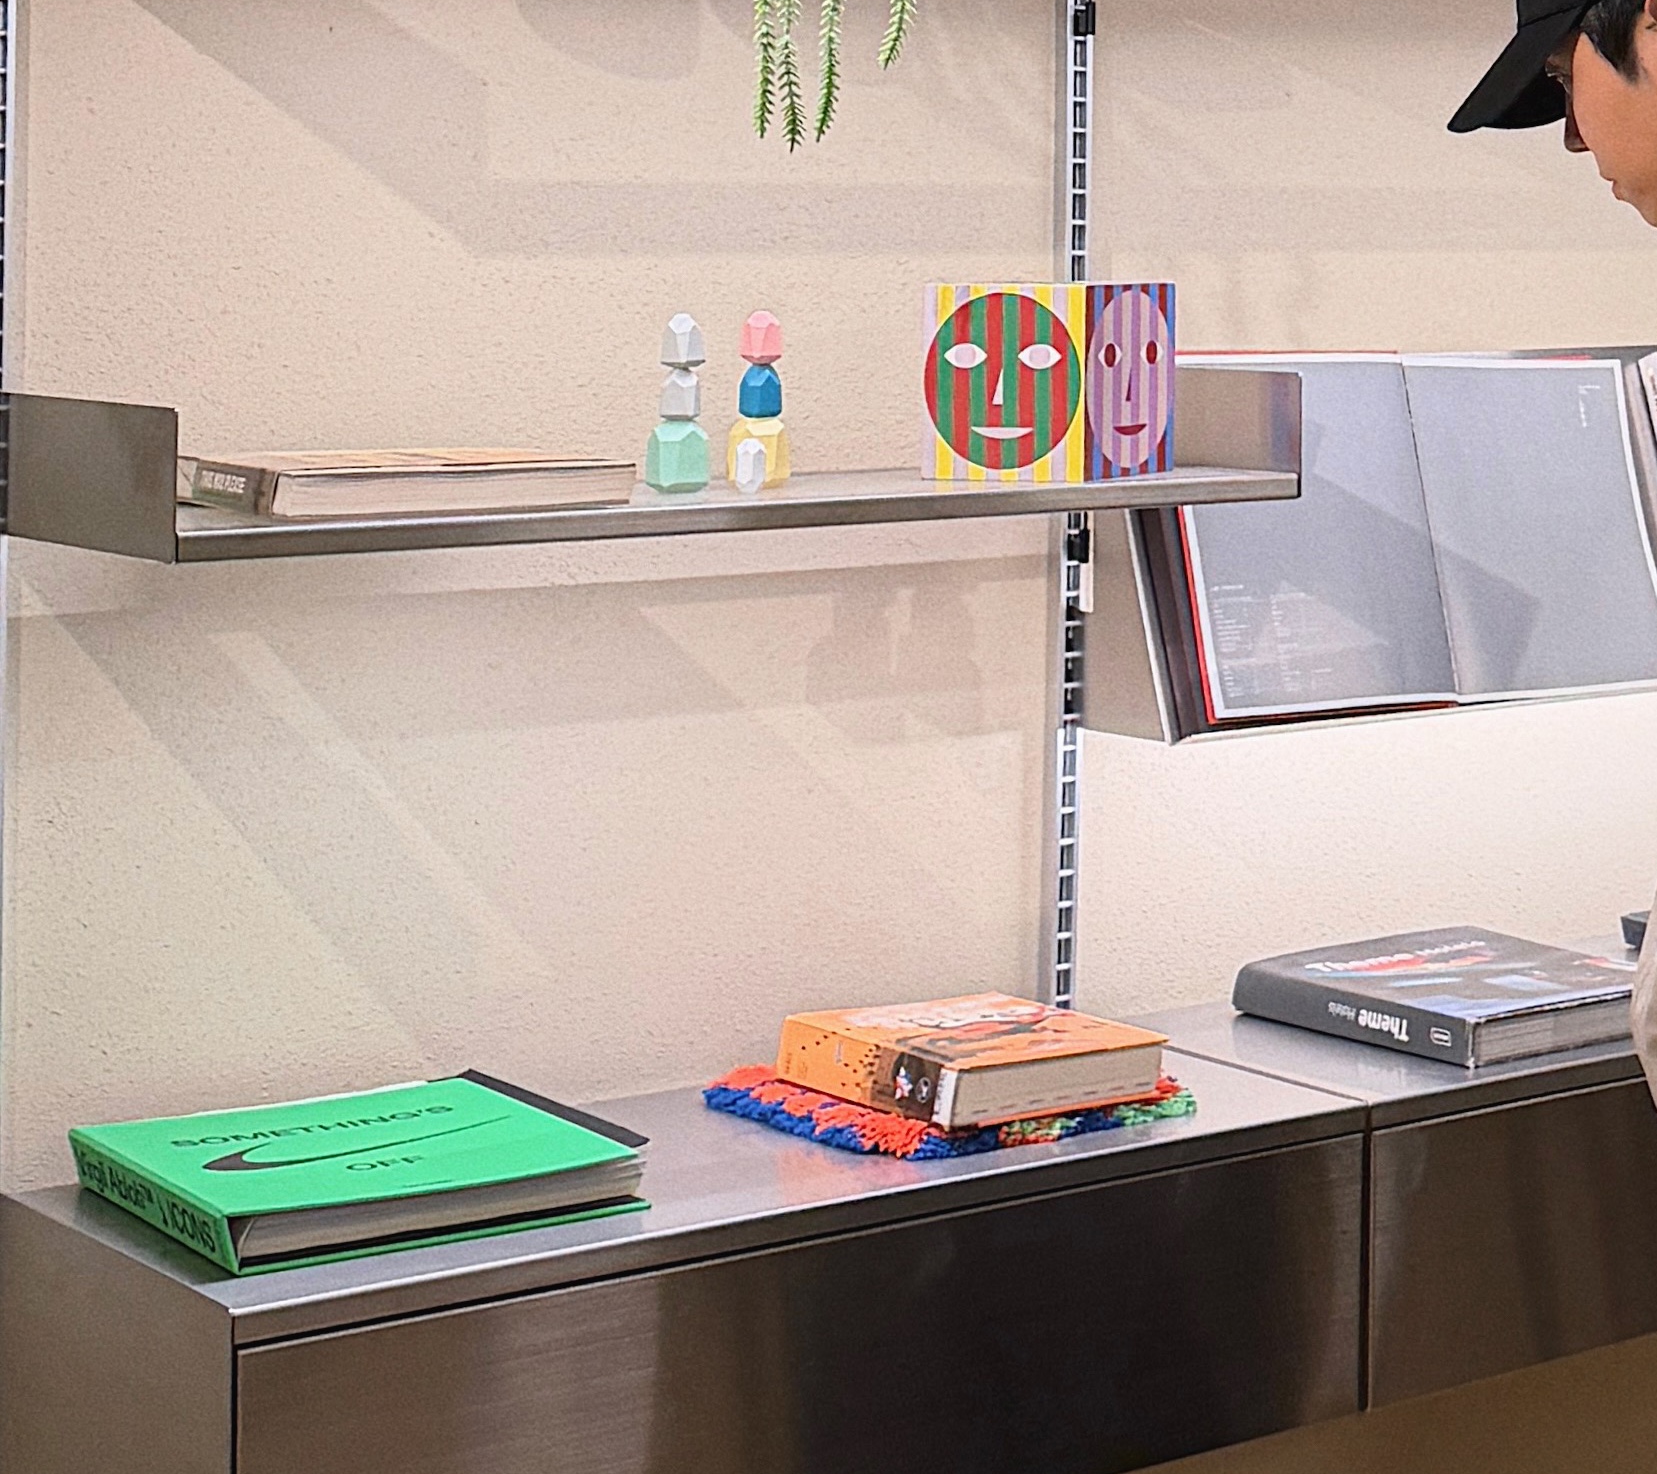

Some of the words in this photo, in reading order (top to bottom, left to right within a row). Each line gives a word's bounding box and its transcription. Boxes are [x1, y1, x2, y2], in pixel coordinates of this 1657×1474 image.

[1304, 953, 1415, 973] Theme
[1357, 1008, 1410, 1043] Theme
[171, 1105, 454, 1148] SOMETHING'S
[345, 1155, 424, 1172] OFF
[166, 1200, 217, 1254] ICONS
